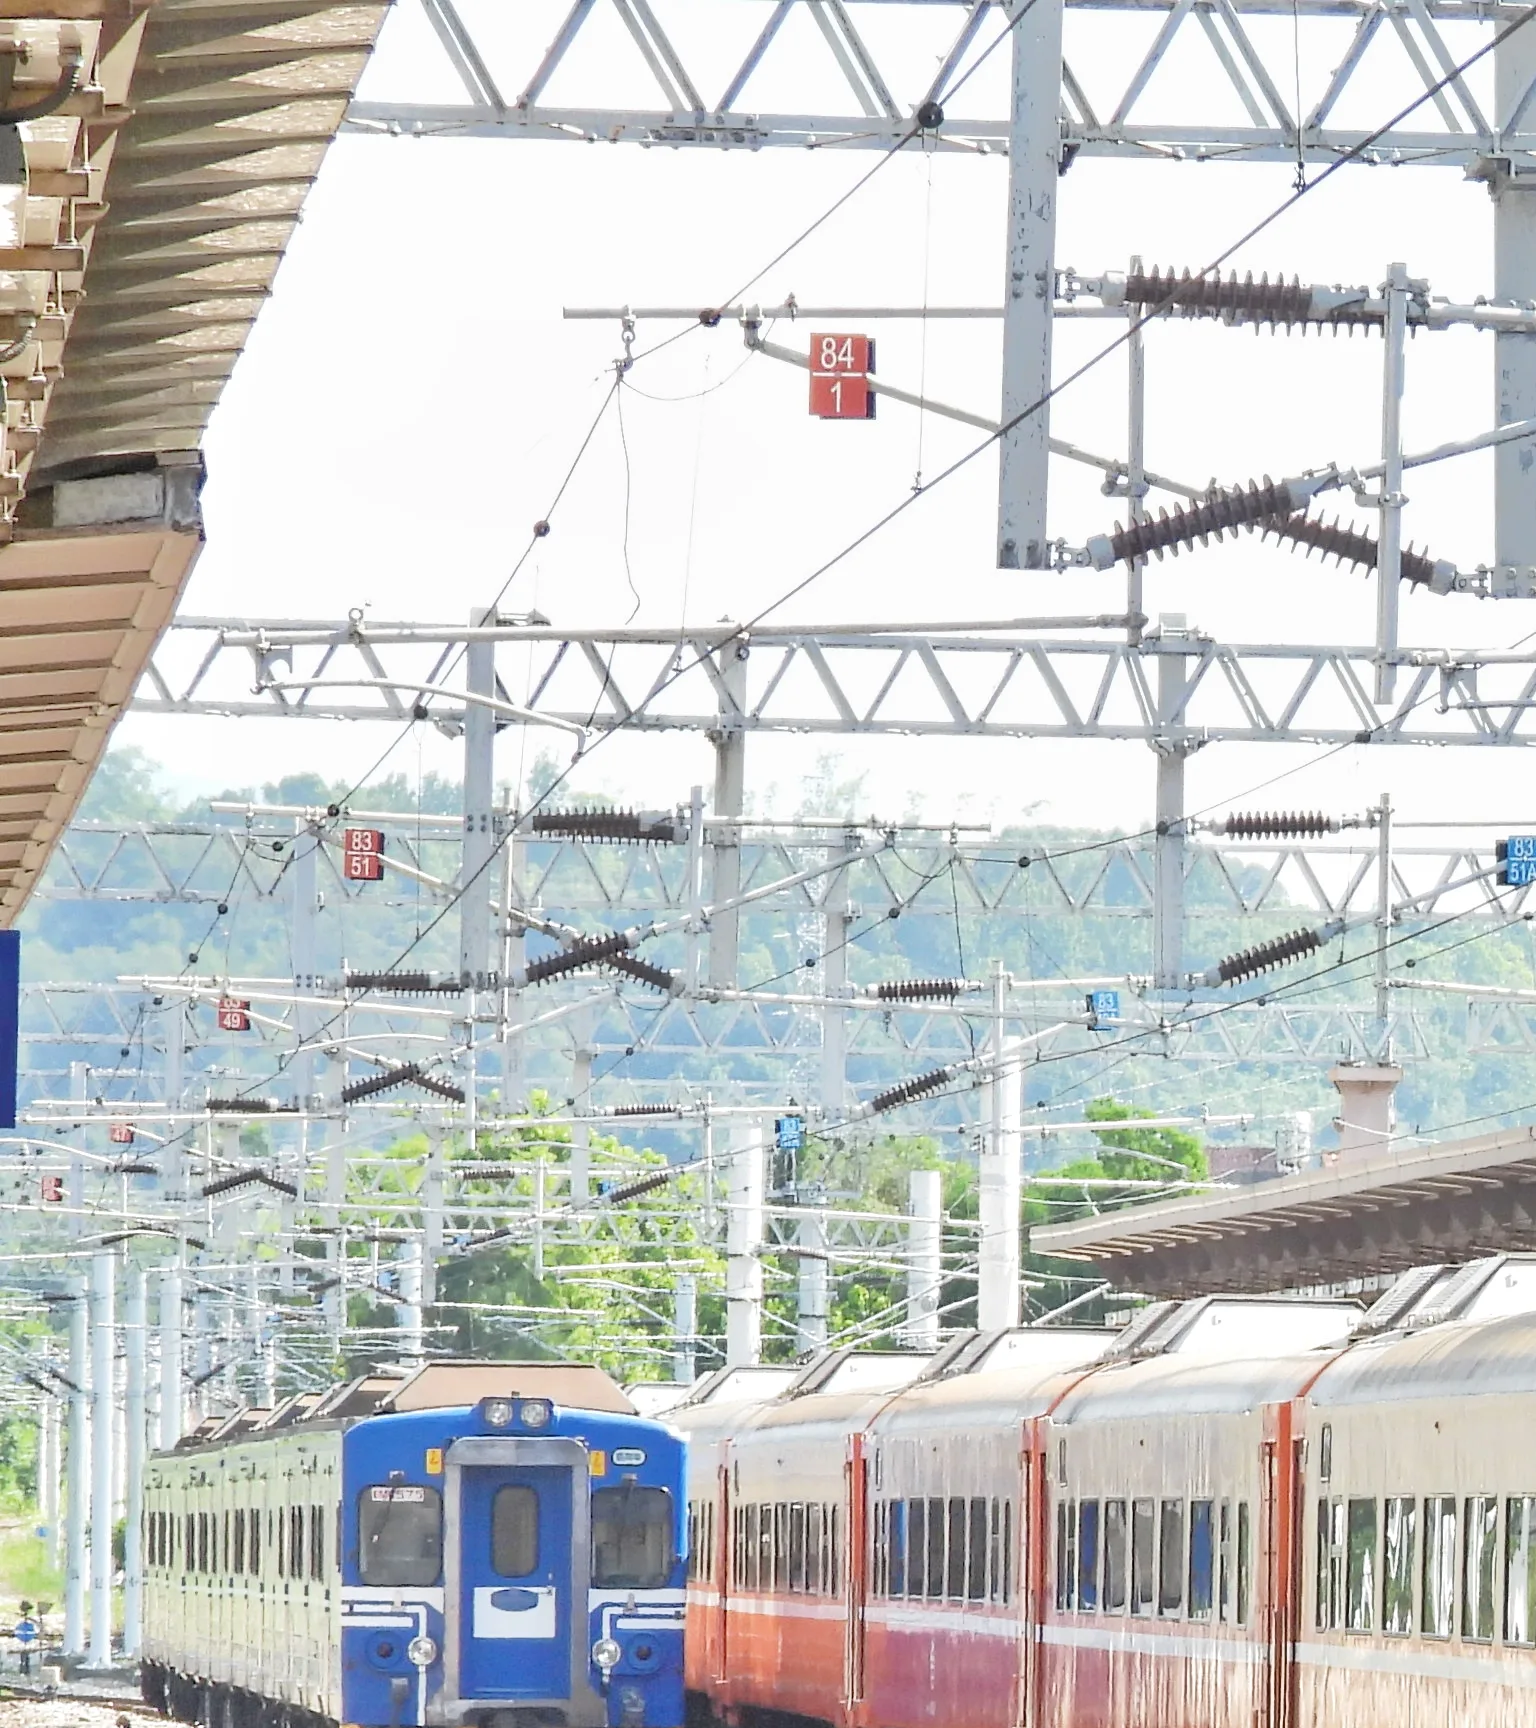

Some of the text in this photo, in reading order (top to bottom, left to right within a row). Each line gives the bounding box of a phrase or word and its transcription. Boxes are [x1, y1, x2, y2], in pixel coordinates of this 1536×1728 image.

[821, 337, 855, 369] 84
[830, 381, 842, 413] 1
[351, 831, 373, 851] 83
[1514, 837, 1534, 857] 83
[351, 856, 371, 877] 51
[223, 1012, 241, 1029] 49
